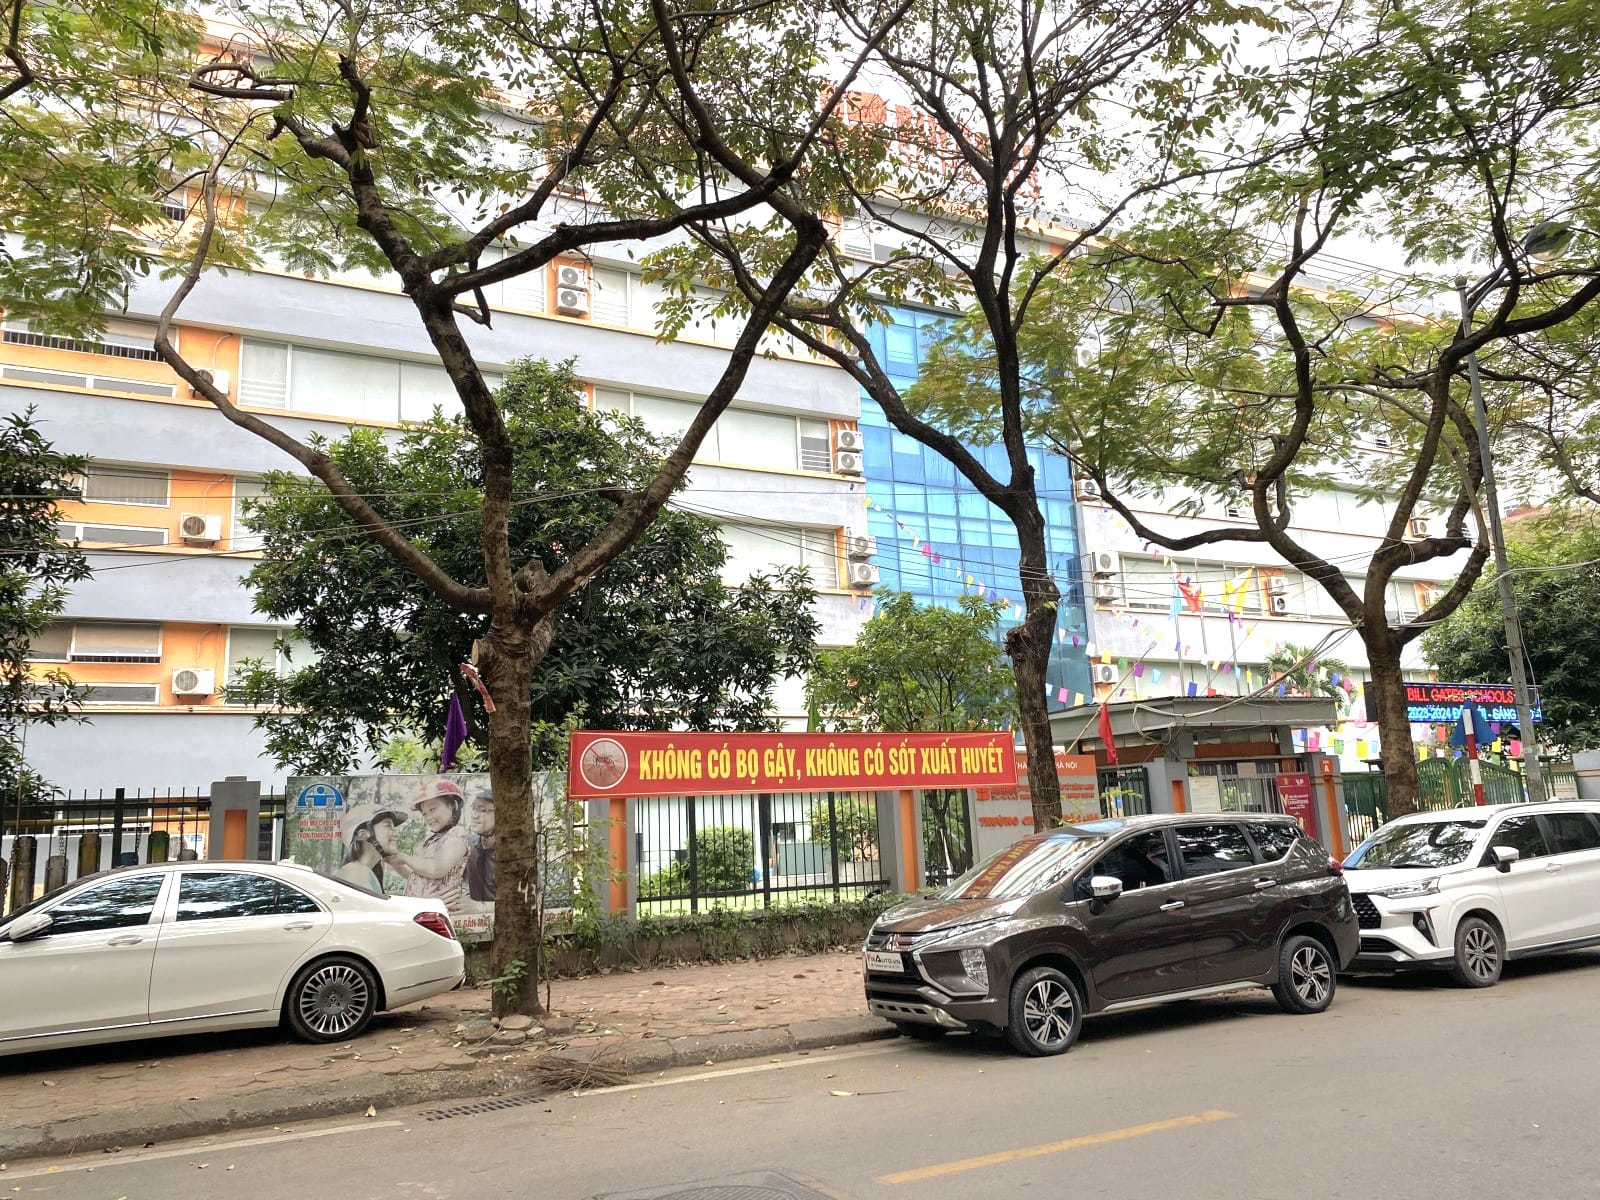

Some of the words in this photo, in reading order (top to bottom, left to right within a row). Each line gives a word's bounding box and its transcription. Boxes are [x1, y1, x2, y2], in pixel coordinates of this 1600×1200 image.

[1407, 687, 1430, 702] BILL
[1431, 688, 1464, 702] GATES
[1467, 689, 1514, 703] SCHOOLS
[1407, 706, 1452, 719] 2023-2024
[639, 743, 702, 780] KHÔNG
[707, 743, 731, 779] CÓ
[736, 748, 759, 784] BỌ
[764, 742, 801, 784] GẬY,
[806, 742, 860, 777] KHÔNG
[864, 742, 884, 776] CÓ
[889, 738, 917, 775] SỐT
[921, 737, 957, 775] XUẤT
[961, 737, 1004, 774] HUYẾT
